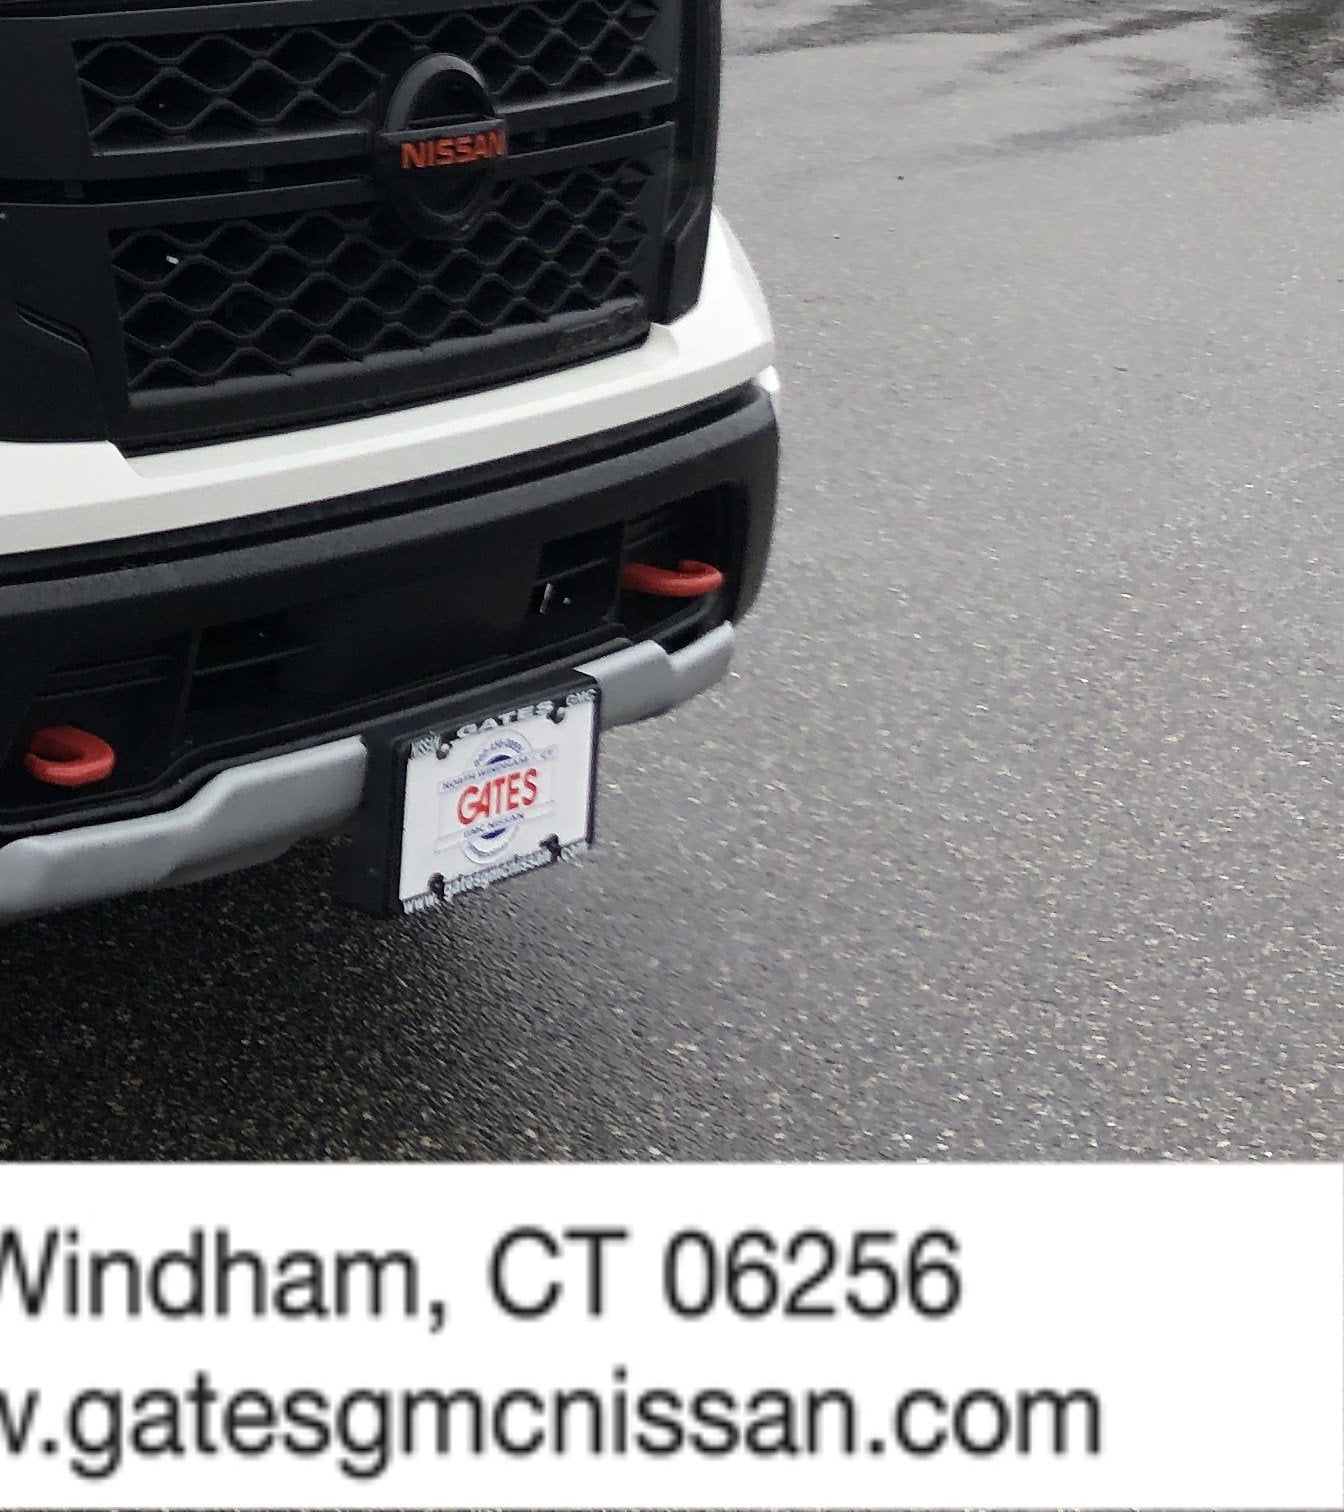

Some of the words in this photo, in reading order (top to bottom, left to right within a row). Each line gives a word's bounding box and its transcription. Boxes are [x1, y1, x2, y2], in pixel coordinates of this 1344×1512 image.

[401, 129, 506, 169] NISSAN
[457, 700, 554, 739] GATES
[457, 768, 537, 825] GATES
